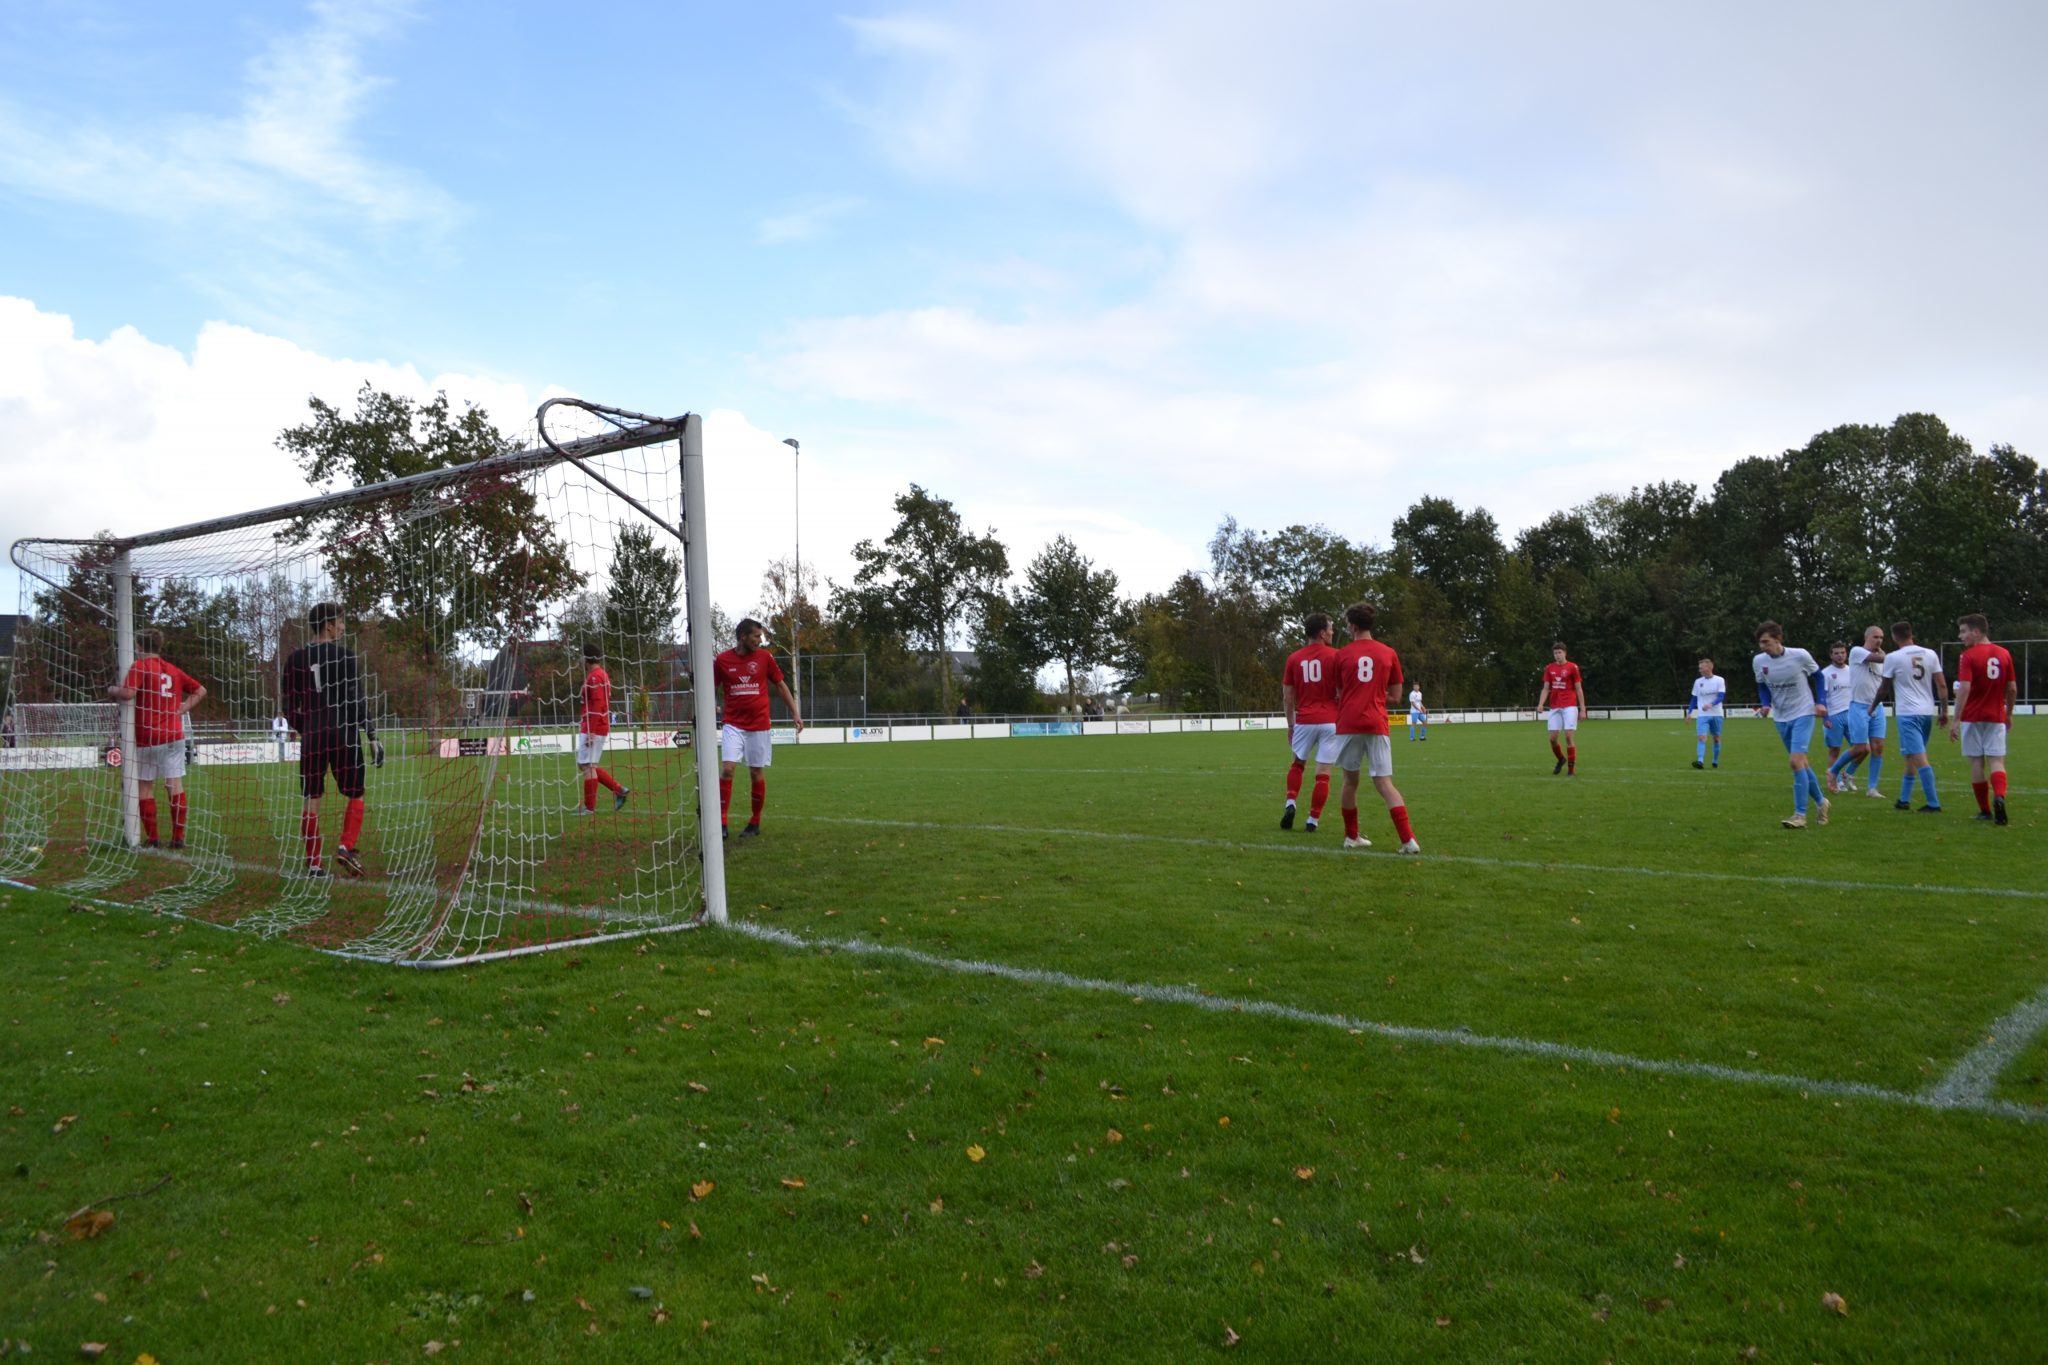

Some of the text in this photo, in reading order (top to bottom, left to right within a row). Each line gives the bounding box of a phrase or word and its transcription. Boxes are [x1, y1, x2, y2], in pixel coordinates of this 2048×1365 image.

[310, 663, 322, 693] 1
[1301, 659, 1322, 683] 10
[1358, 656, 1373, 682] 8
[1912, 656, 1925, 680] 5
[1987, 657, 1999, 680] 6
[160, 673, 173, 698] 2
